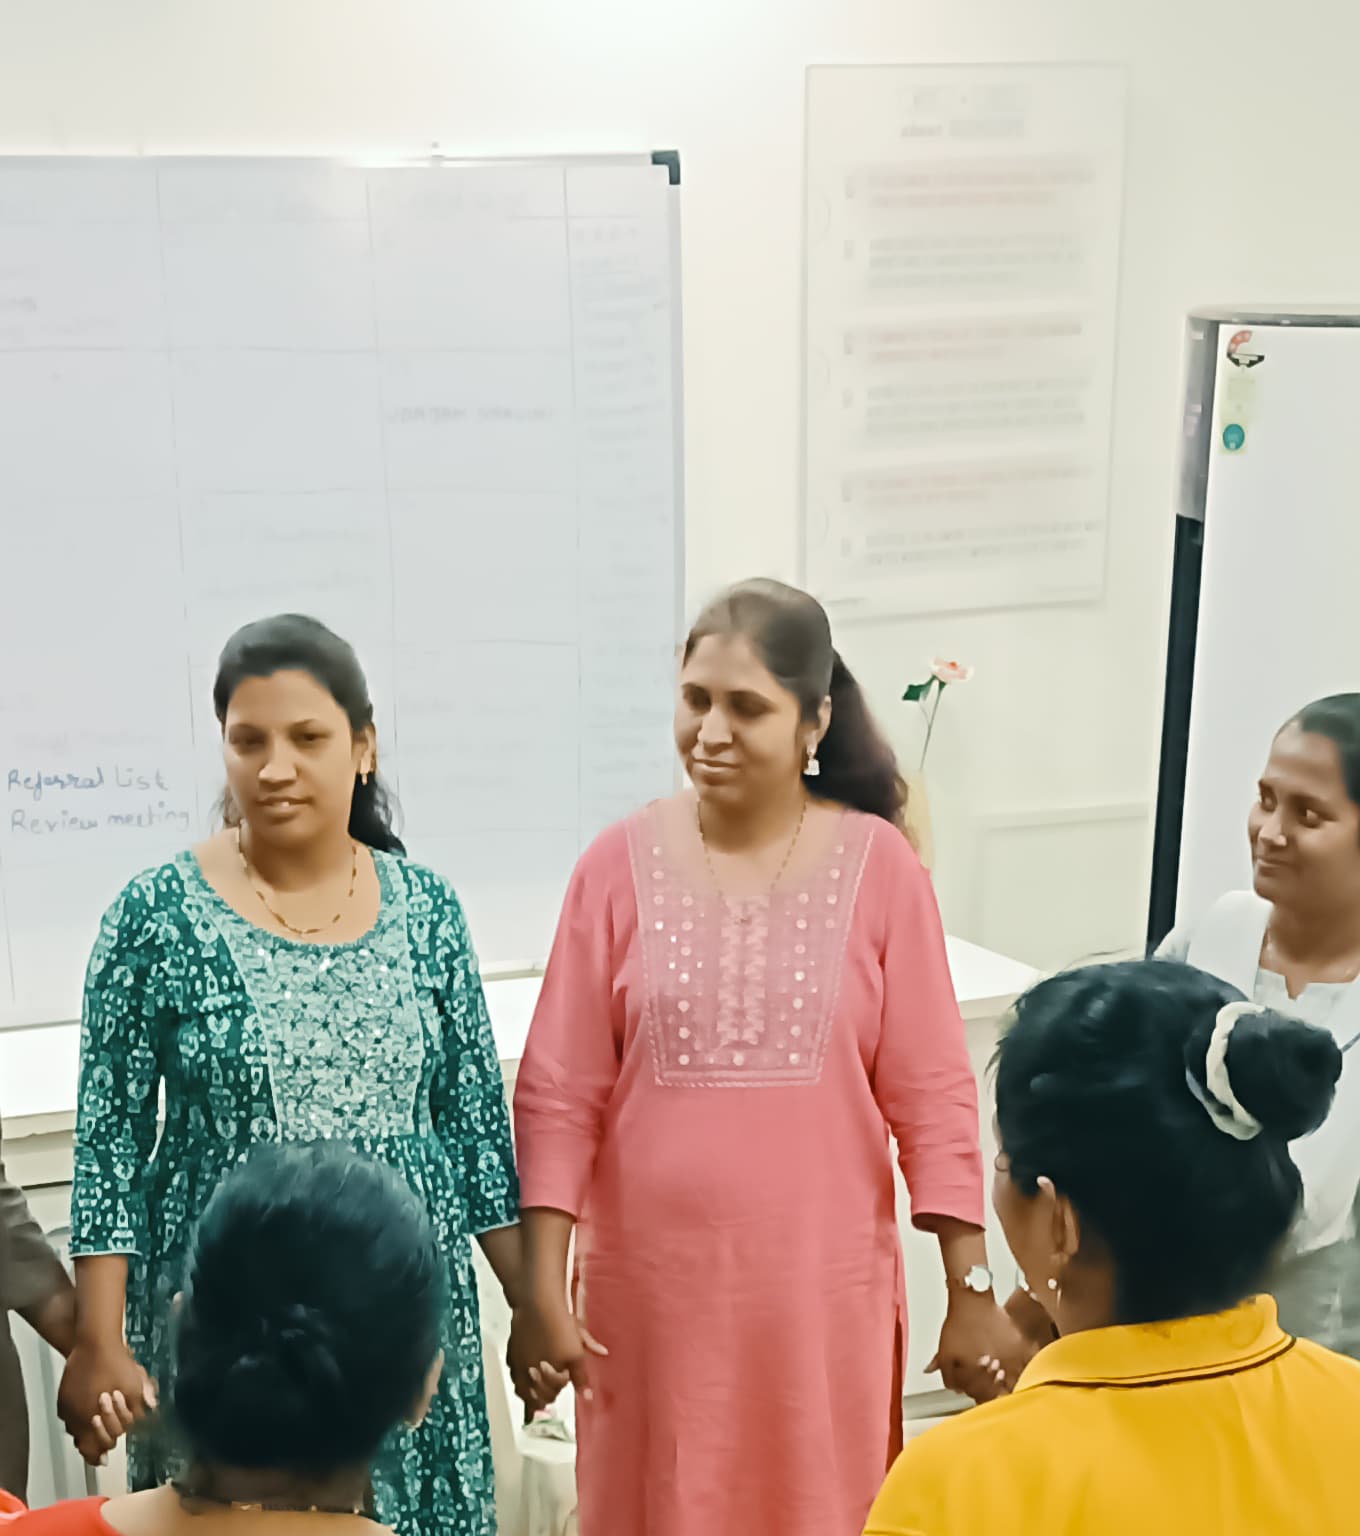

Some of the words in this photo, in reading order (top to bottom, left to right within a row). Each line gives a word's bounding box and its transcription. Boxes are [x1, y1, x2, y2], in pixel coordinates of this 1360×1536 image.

[7, 767, 104, 801] Referral
[10, 808, 98, 834] Review
[107, 802, 190, 830] meeting
